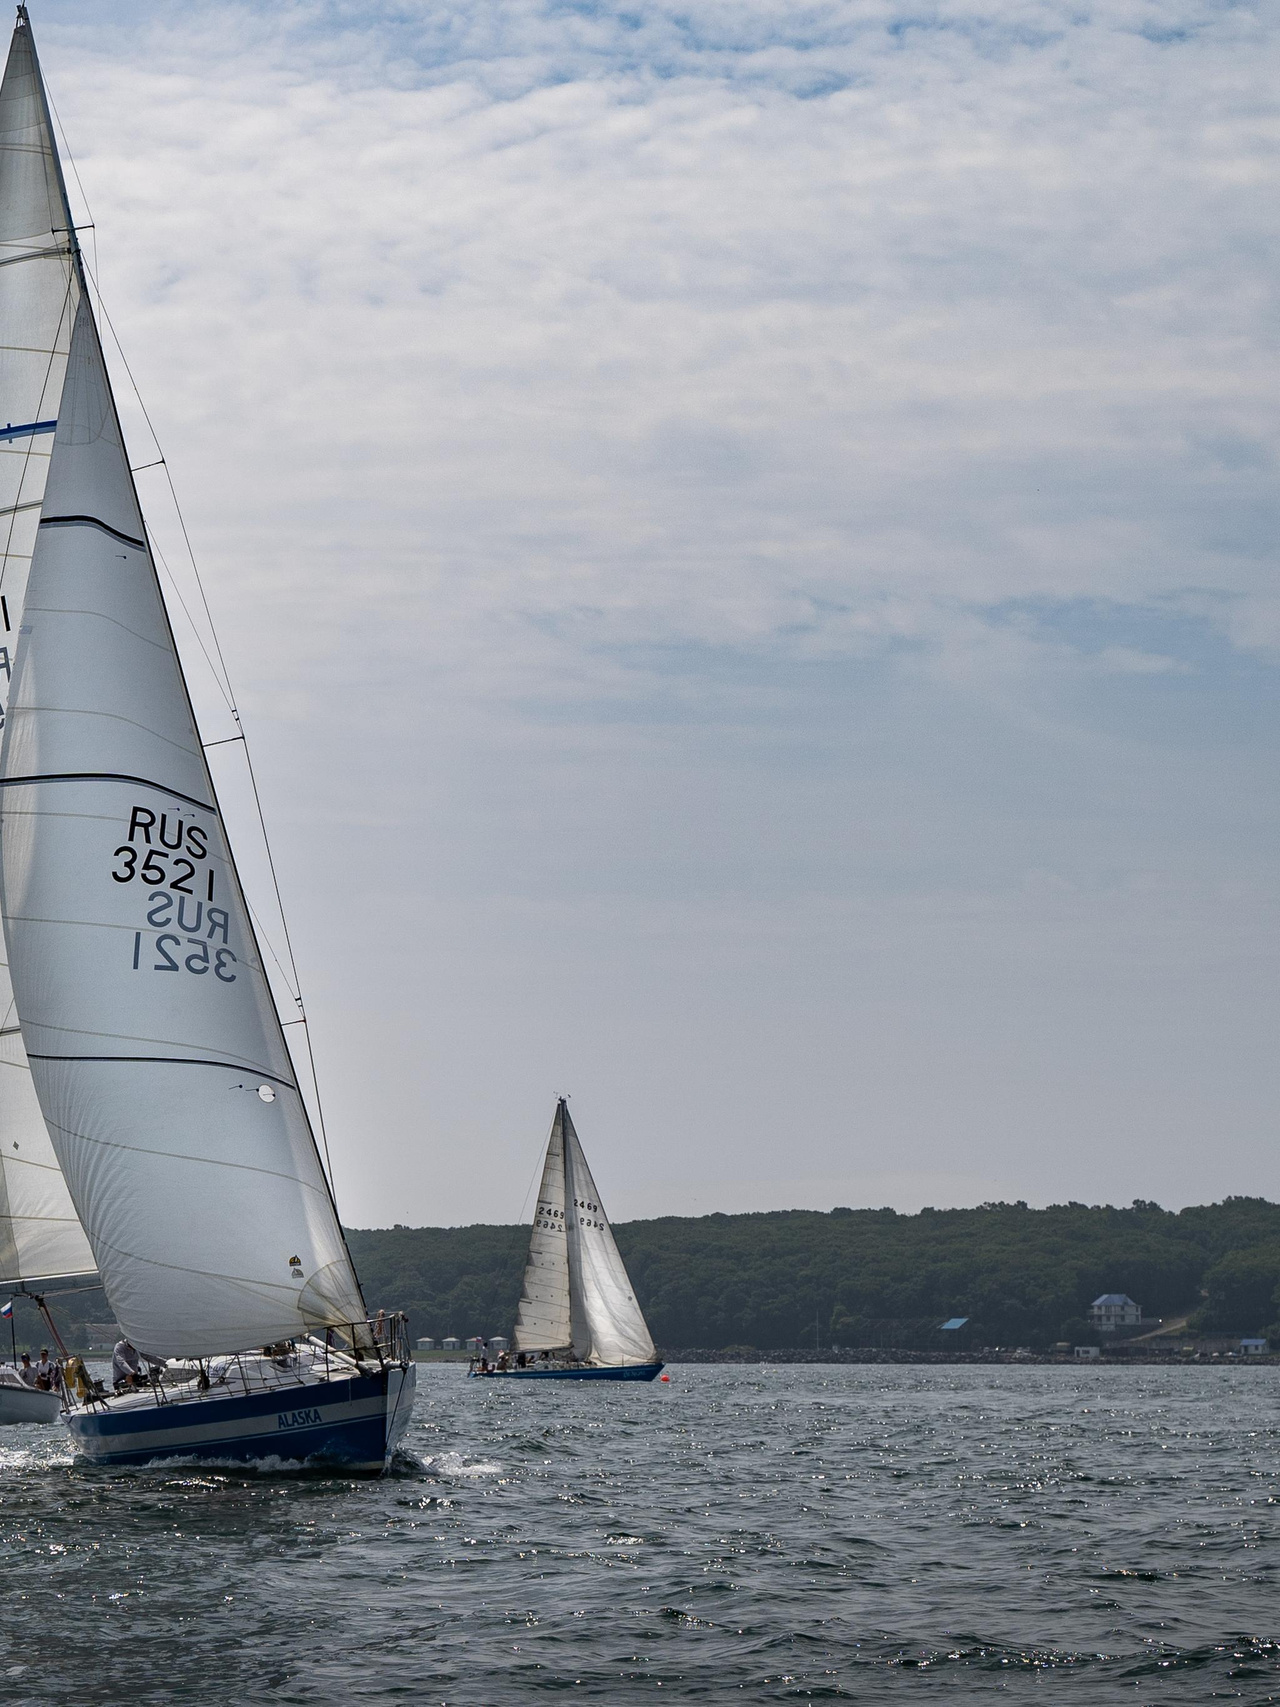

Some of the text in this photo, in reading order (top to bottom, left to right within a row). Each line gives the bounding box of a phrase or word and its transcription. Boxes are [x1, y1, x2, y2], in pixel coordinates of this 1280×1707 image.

[127, 805, 208, 860] RUS
[111, 845, 214, 902] 3521
[538, 1206, 565, 1219] 2469
[573, 1199, 598, 1213] 2469
[277, 1408, 323, 1429] ALASKA
